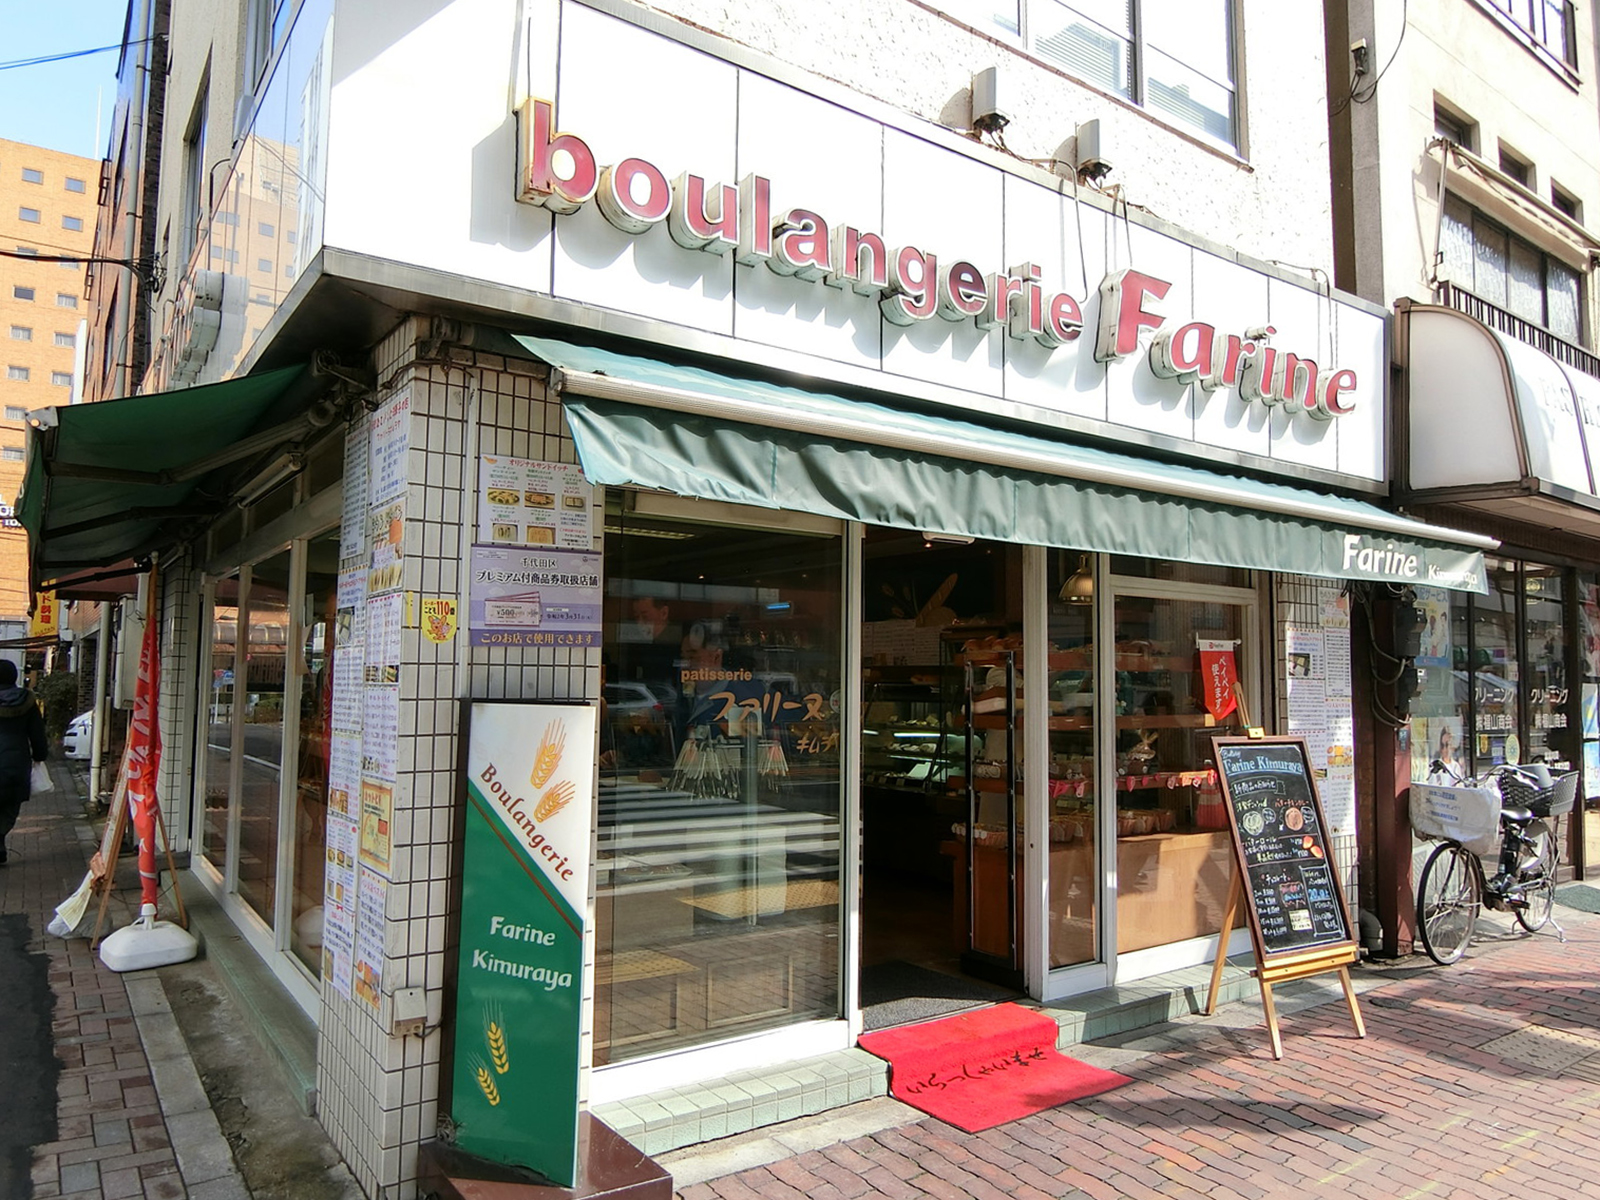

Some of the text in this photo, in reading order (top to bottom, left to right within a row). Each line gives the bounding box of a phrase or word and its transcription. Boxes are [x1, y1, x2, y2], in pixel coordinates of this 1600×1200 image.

[514, 97, 1358, 416] boulangerie Farine
[509, 459, 568, 471] オリジナルサンドイッチ
[522, 558, 557, 568] 千代田区
[1343, 534, 1417, 577] Farine
[477, 570, 599, 586] プレミアム付商品券取扱店舗
[481, 633, 594, 645] このお店で使用できます
[680, 668, 753, 683] patisserie
[1219, 656, 1229, 699] ペイペイ
[709, 691, 825, 722] ファリーヌ
[1531, 688, 1568, 704] クリーニング
[1223, 756, 1303, 774] Farine Kimuraya
[480, 762, 574, 882] Boulangerie
[490, 915, 555, 946] Farine
[472, 949, 572, 991] Kimuraya
[906, 1047, 1047, 1093] いらっしゃいませ
